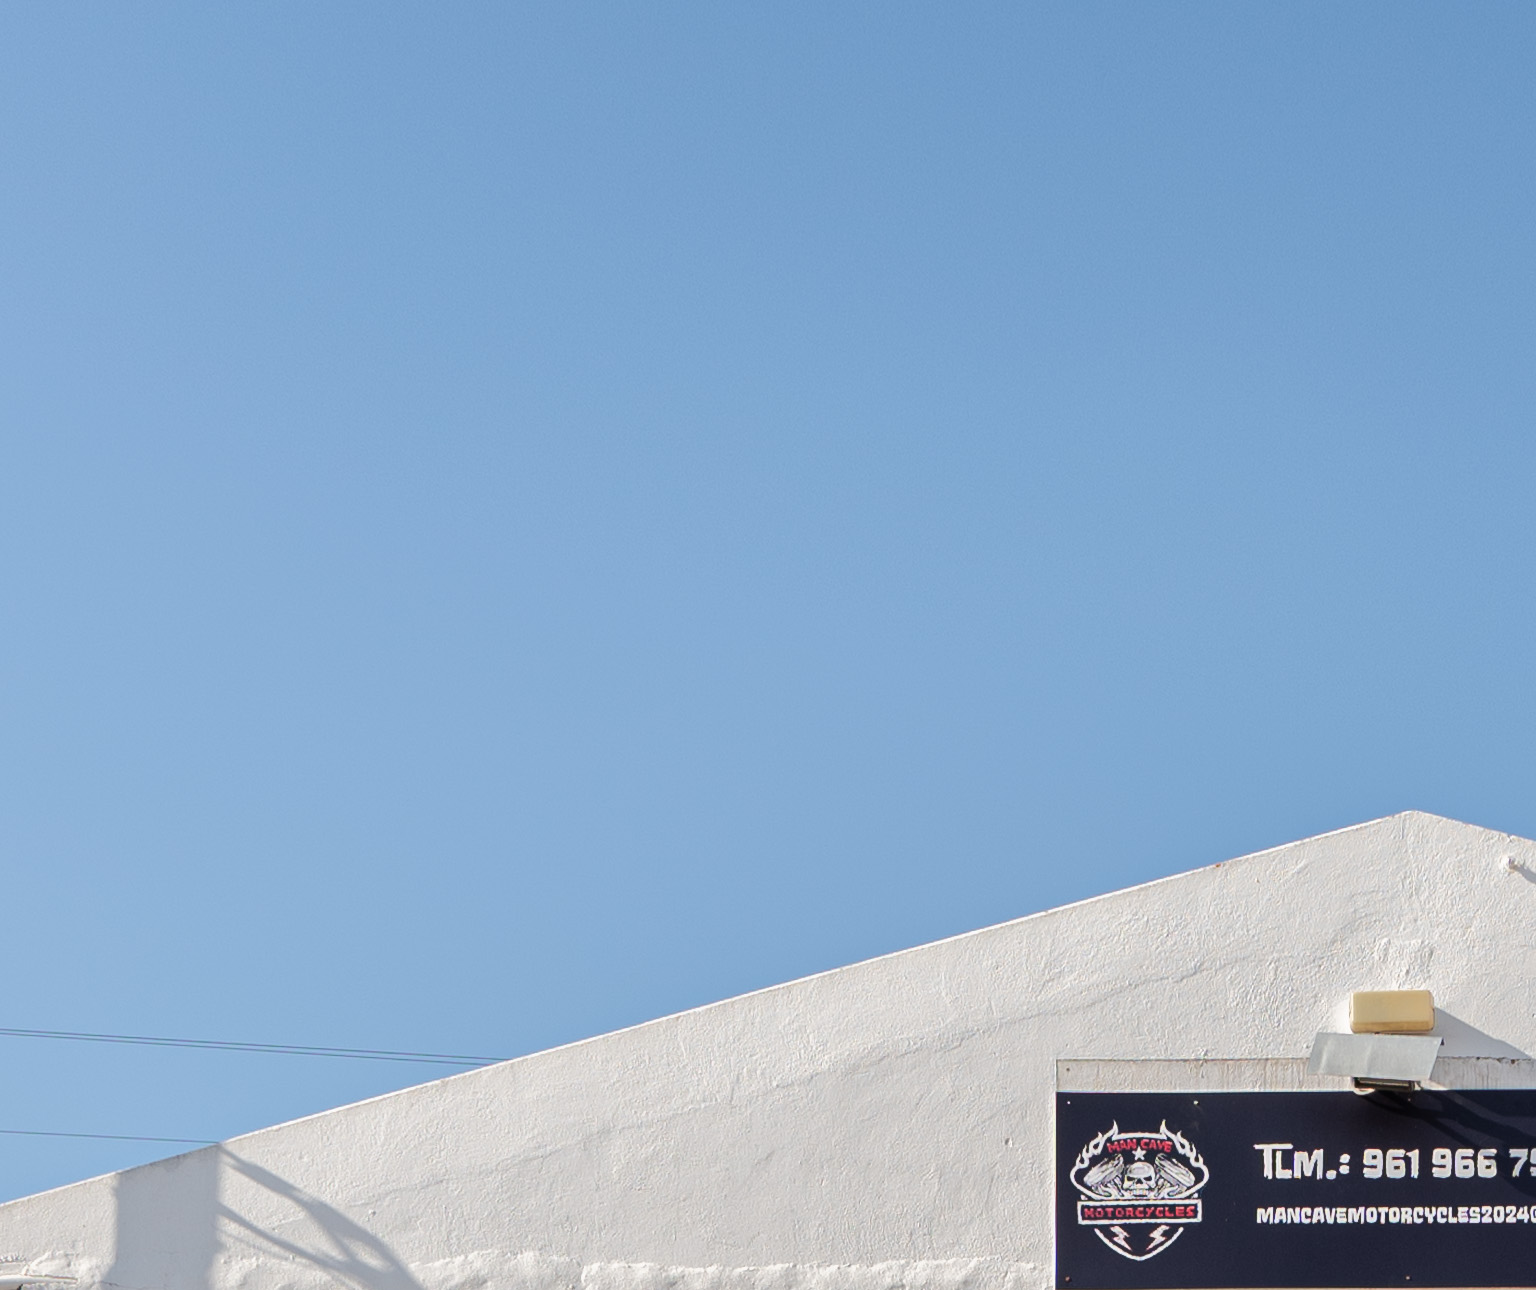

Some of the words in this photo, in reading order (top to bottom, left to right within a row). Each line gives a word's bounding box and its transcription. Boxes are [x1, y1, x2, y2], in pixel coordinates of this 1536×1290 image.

[1107, 1139, 1137, 1153] MAN
[1140, 1139, 1173, 1153] CAVE
[1362, 1148, 1420, 1180] 961
[1431, 1147, 1498, 1179] 966
[1084, 1205, 1196, 1218] MOTORCYCLES
